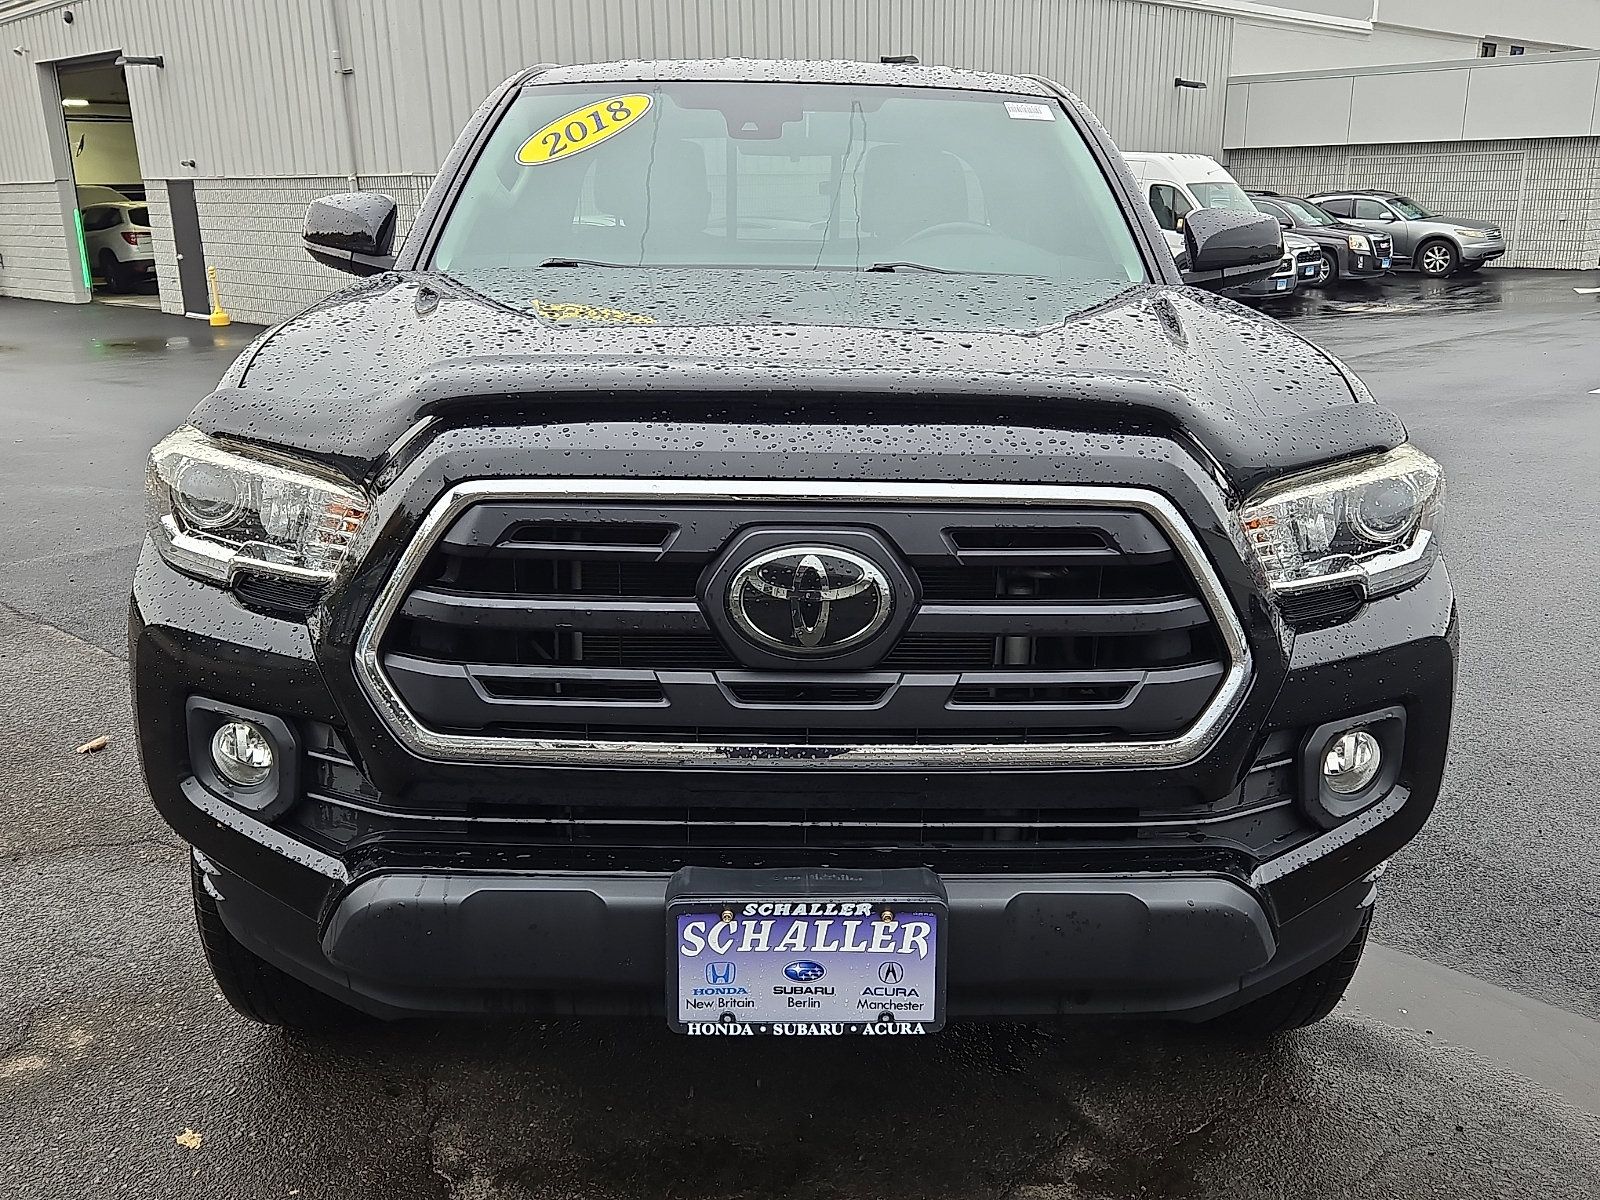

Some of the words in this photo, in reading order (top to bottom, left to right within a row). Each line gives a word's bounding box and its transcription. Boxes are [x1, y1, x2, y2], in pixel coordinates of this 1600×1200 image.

[541, 100, 632, 157] 2018
[742, 903, 873, 917] SCHALLER
[680, 920, 931, 960] SCHALLER
[693, 987, 748, 996] HONDA
[773, 986, 835, 995] SUBARU
[862, 987, 919, 997] ACURA
[686, 998, 714, 1010] New
[718, 997, 755, 1008] Britain
[787, 997, 821, 1008] Berlin
[857, 998, 925, 1011] Manchester
[687, 1023, 754, 1035] HONDA
[773, 1023, 845, 1035] SUBARU
[862, 1022, 926, 1035] ACURA
